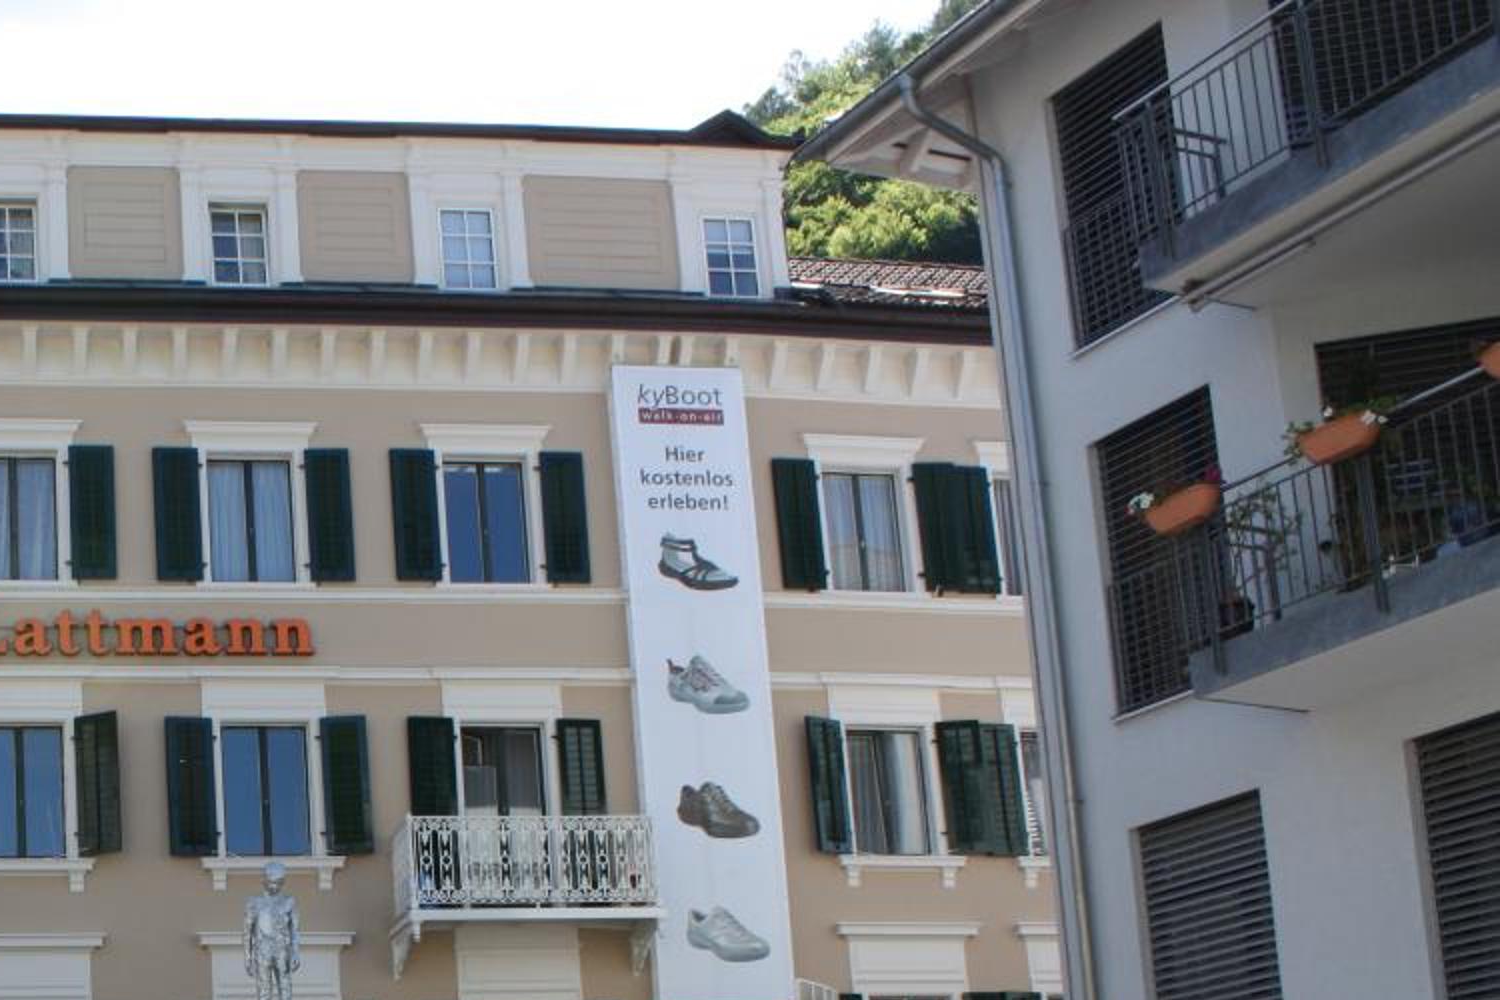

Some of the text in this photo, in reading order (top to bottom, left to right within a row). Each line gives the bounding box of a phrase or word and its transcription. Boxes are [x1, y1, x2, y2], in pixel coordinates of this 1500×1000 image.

[637, 384, 722, 408] kyBoot
[664, 446, 704, 462] Hier
[639, 469, 734, 487] kostenlos
[647, 493, 729, 511] erleben!
